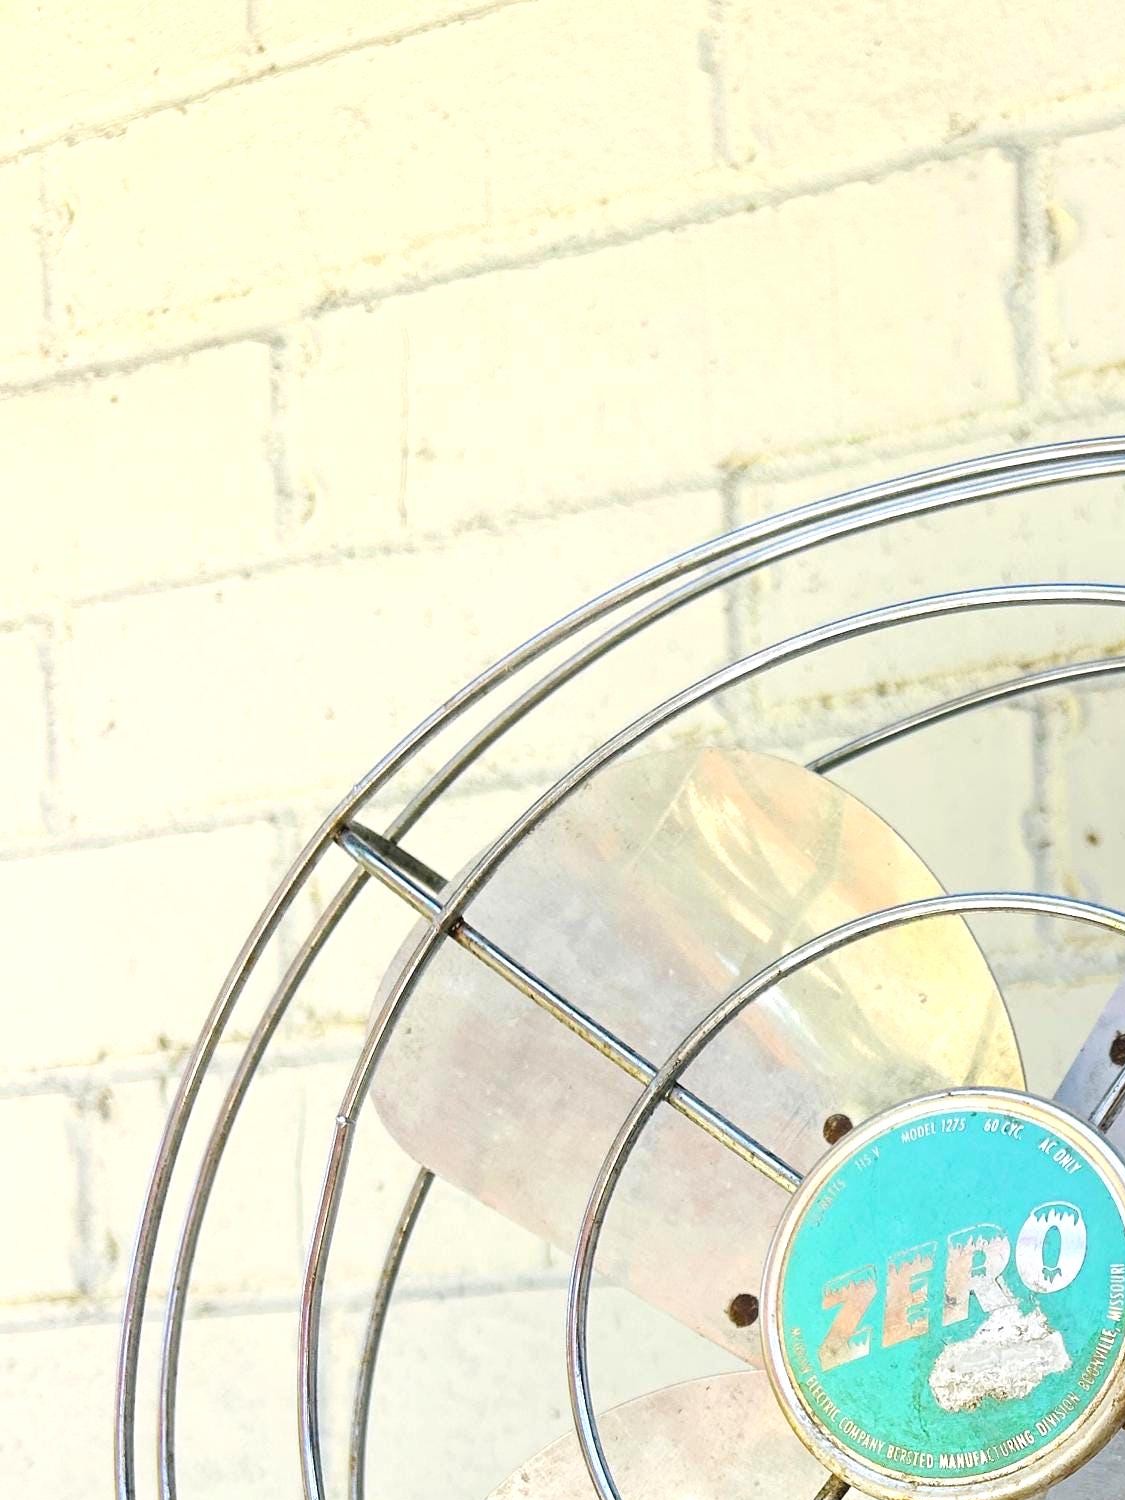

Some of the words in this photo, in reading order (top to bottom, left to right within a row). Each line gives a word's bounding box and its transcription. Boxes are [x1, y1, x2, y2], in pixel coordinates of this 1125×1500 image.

[871, 1145, 881, 1159] V
[900, 1121, 936, 1144] MODEL
[940, 1118, 967, 1133] 1275
[983, 1118, 999, 1132] 60
[1000, 1120, 1025, 1141] CYC.
[1038, 1137, 1058, 1155] AC
[1052, 1149, 1082, 1174] ONLY
[805, 1374, 841, 1423] ELECTRIC
[838, 1416, 885, 1455] COMPANY
[886, 1444, 934, 1469] BERSTED
[939, 1429, 1035, 1470] MANUFACTURING
[1034, 1391, 1081, 1437] DIVISION
[1105, 1263, 1125, 1323] MISSOURI
[817, 1200, 1088, 1372] ZERO
